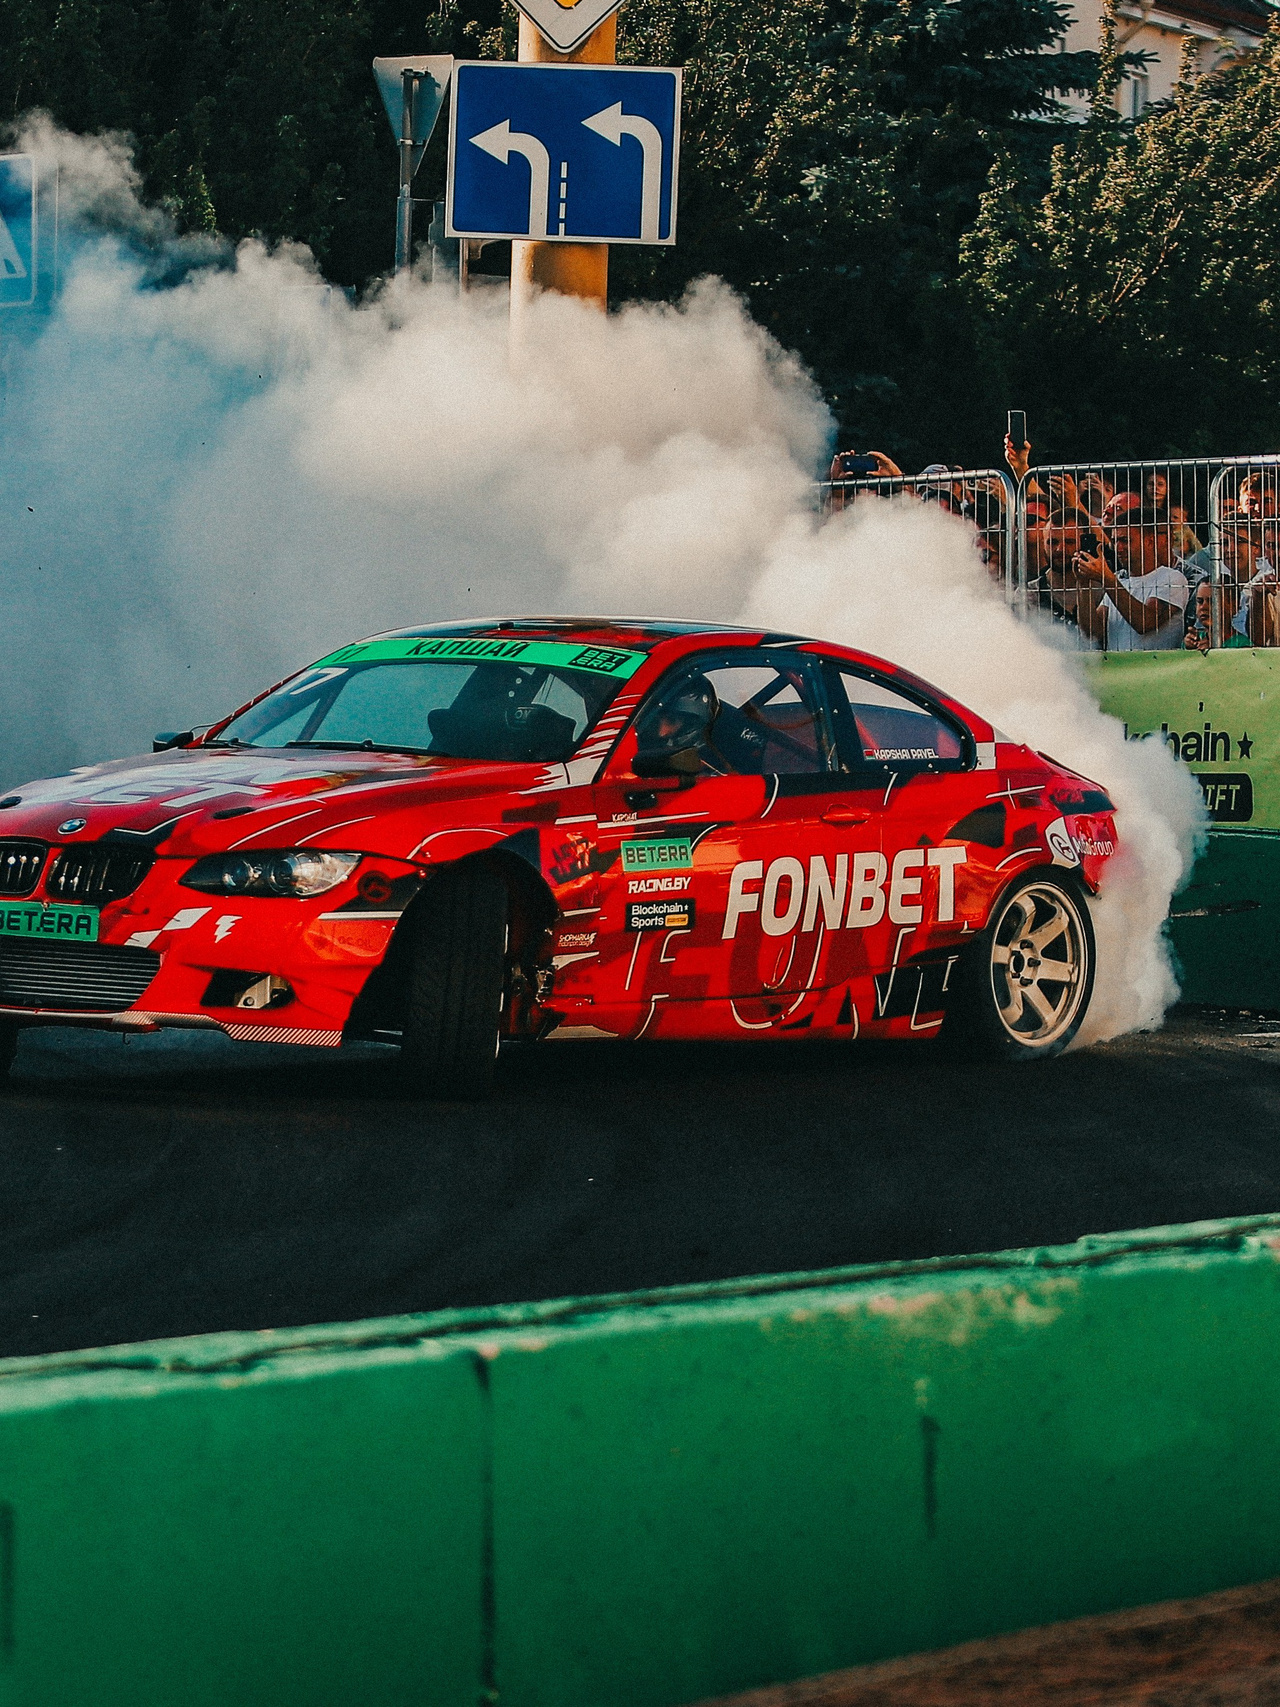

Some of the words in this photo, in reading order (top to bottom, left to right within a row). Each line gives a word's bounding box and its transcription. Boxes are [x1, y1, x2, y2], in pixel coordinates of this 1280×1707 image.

[584, 650, 625, 662] BET
[874, 749, 910, 760] KAPSHAI
[912, 748, 939, 759] PAVEL
[625, 845, 689, 863] BET.ERA
[722, 845, 968, 940] FONBET
[632, 903, 683, 915] Blockchain
[631, 915, 664, 929] Sports
